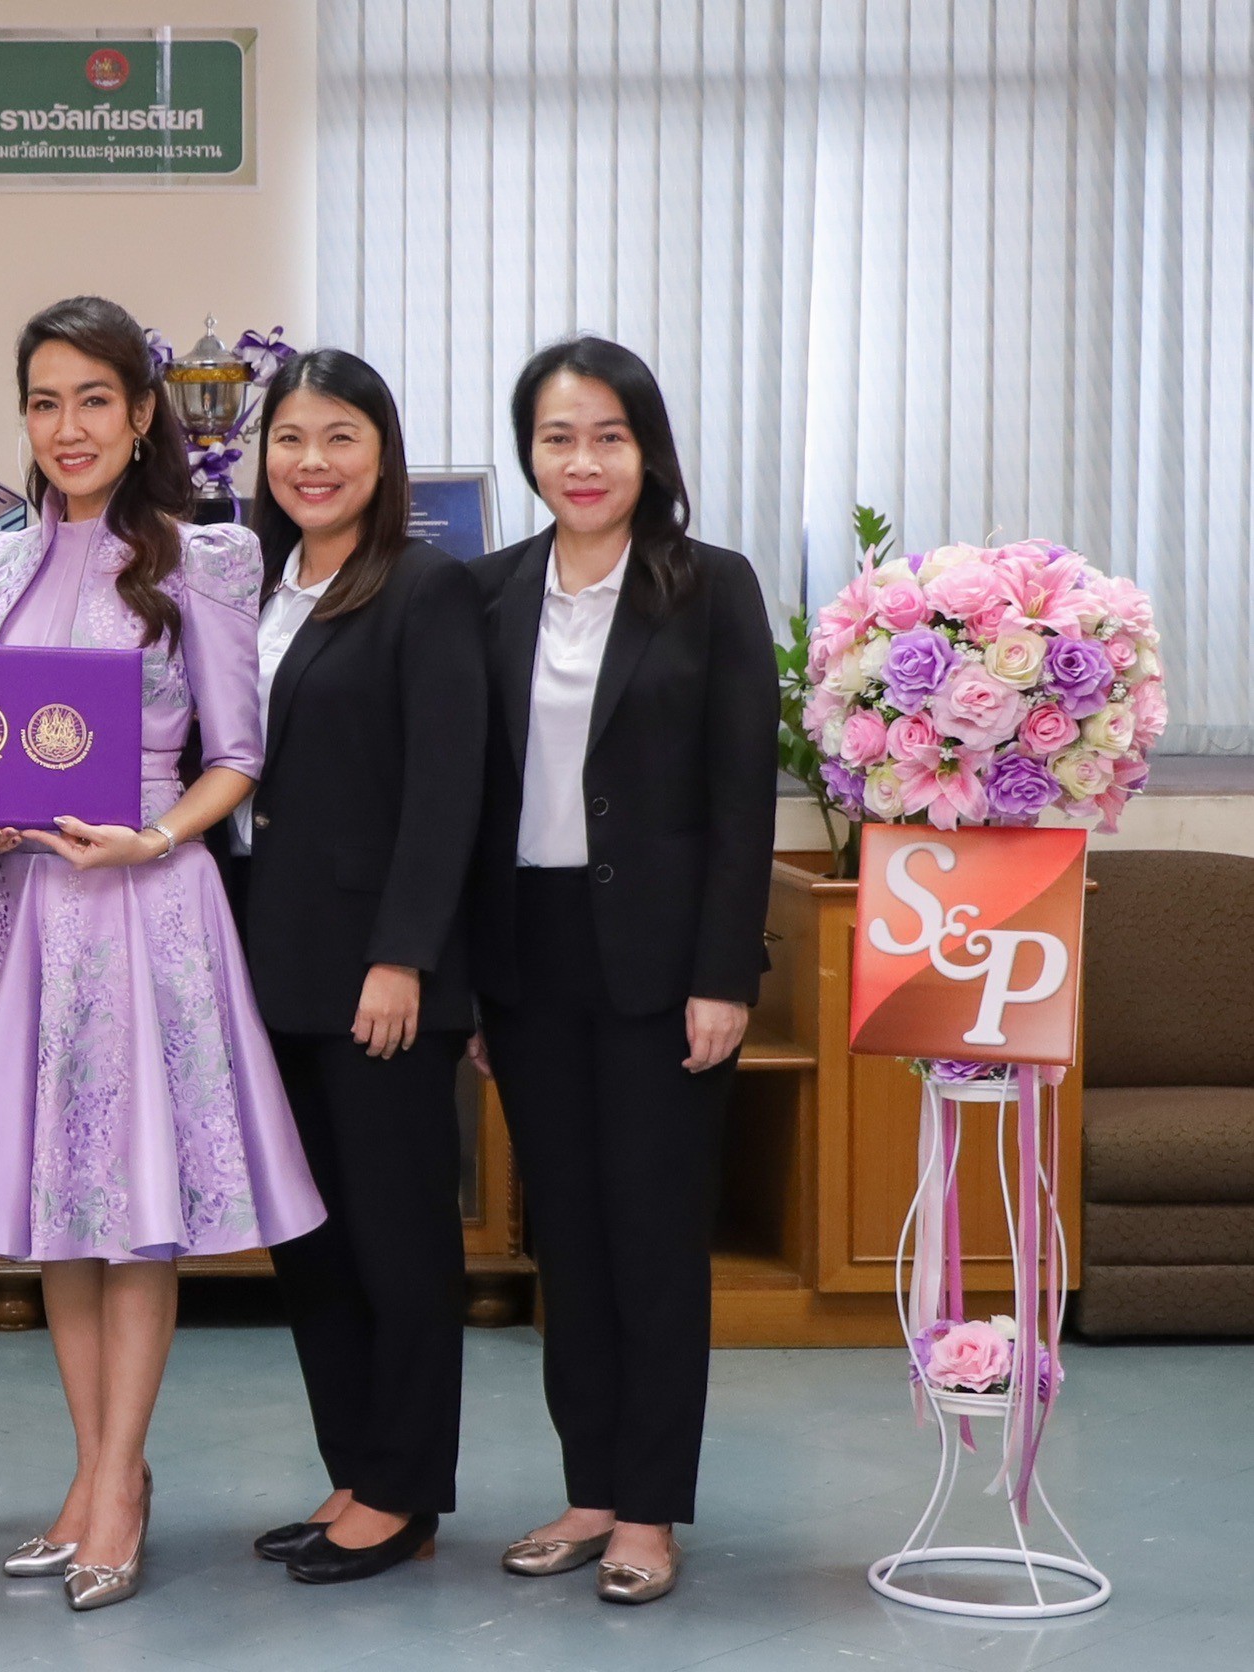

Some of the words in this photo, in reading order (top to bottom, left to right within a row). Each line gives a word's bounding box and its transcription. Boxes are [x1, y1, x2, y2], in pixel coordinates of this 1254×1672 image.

[0, 103, 204, 131] รางวัลเกียรติยศ
[868, 841, 1069, 1046] S&P
